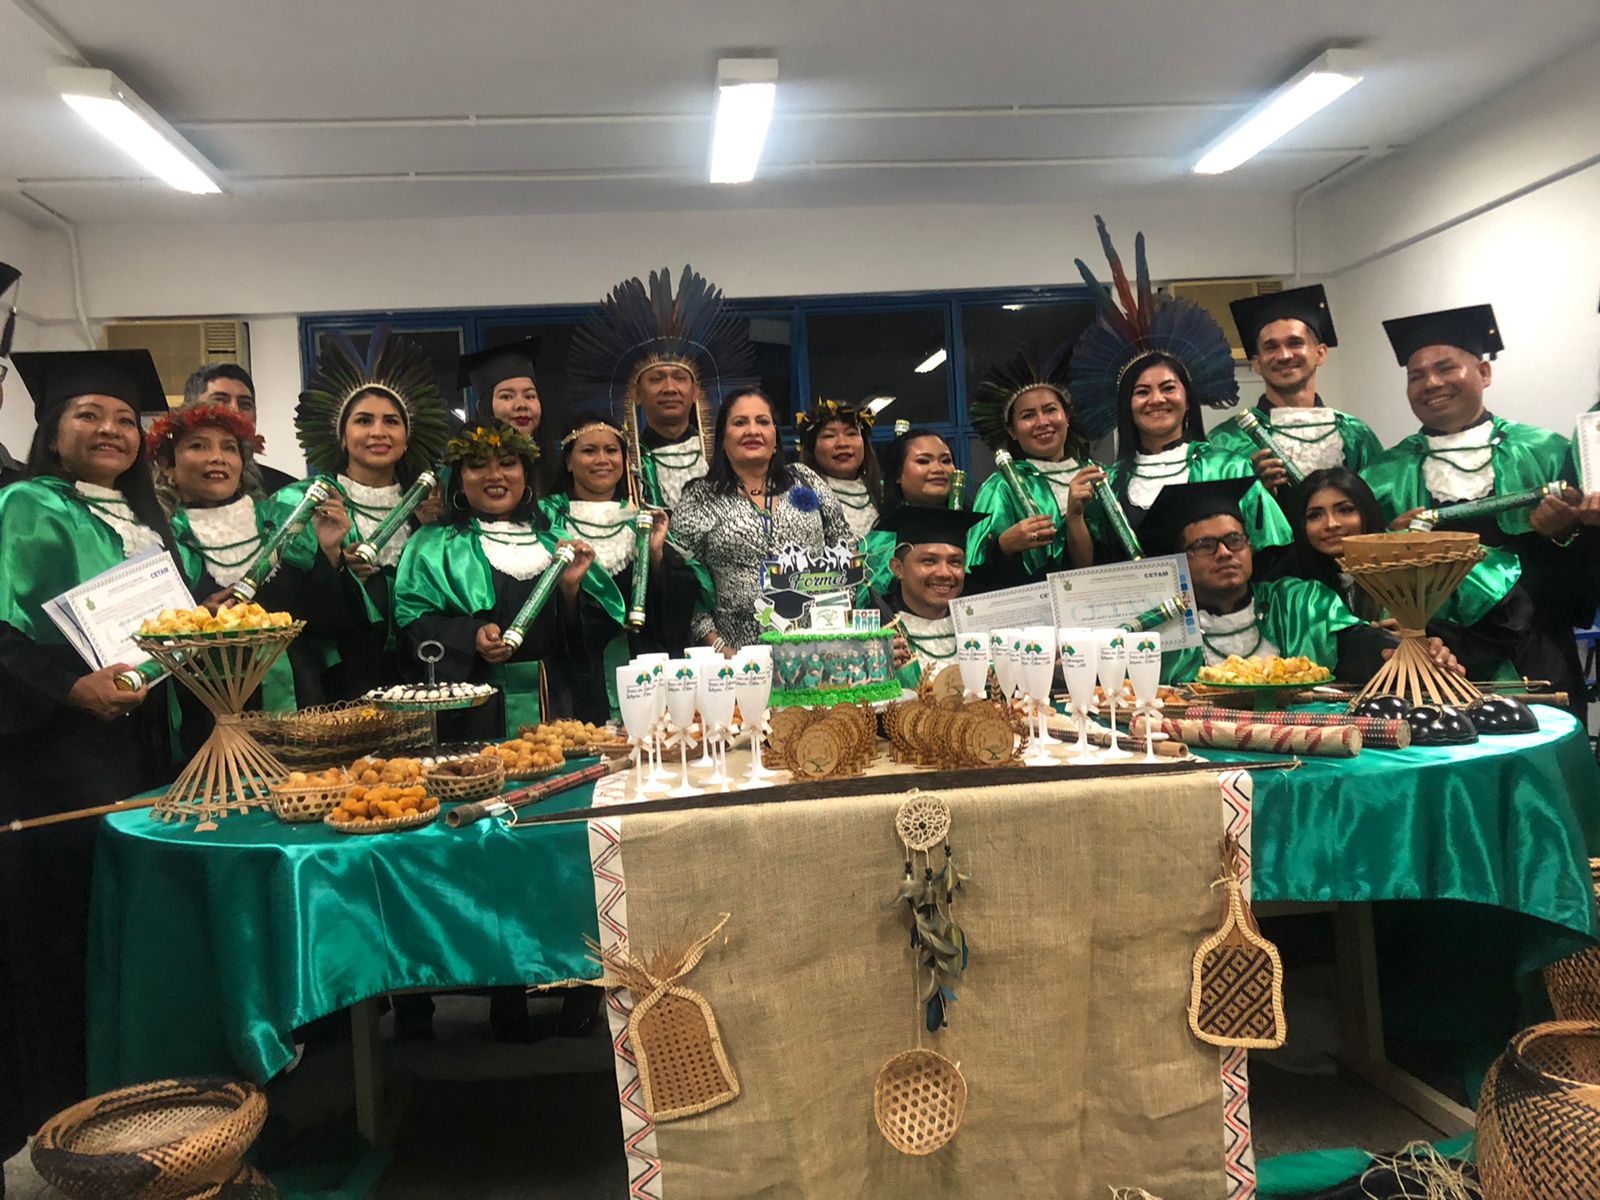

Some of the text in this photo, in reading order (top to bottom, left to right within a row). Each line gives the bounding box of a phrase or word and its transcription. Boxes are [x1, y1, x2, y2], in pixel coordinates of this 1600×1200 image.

[150, 567, 169, 579] CETAM
[1144, 571, 1168, 579] CETAM
[788, 569, 848, 590] Formei
